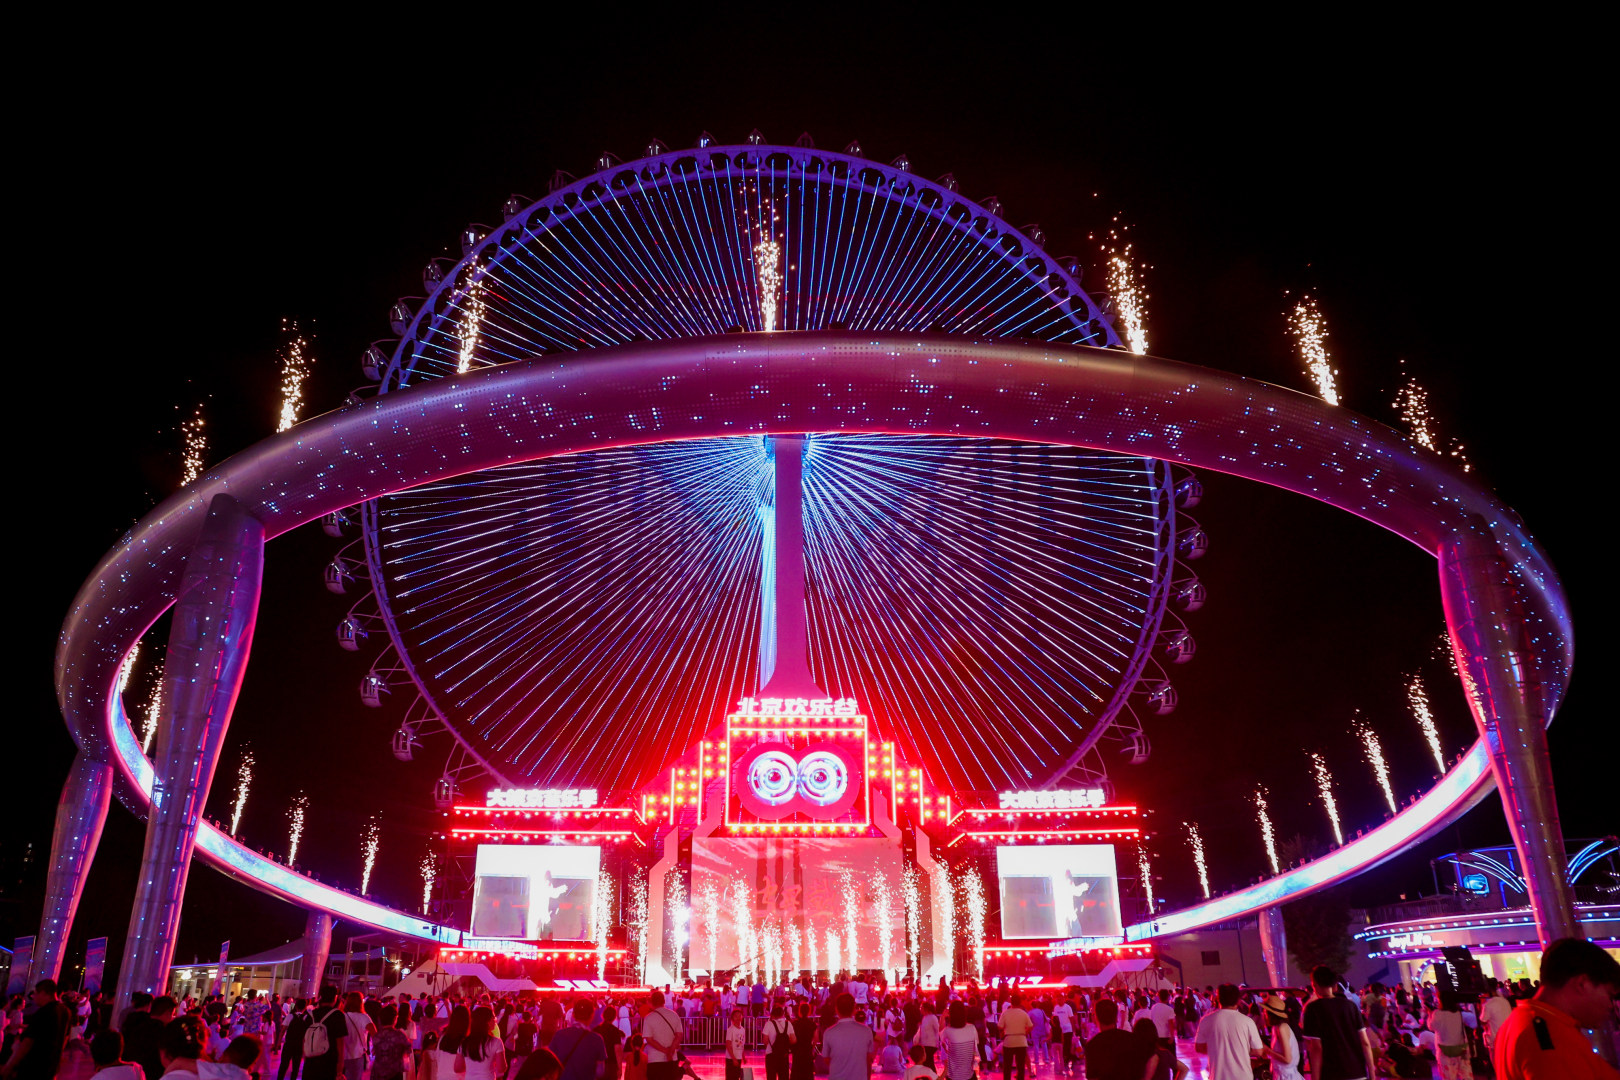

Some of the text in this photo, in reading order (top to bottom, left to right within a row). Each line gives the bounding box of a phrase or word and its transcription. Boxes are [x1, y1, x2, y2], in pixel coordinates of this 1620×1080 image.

[736, 697, 858, 715] 北京欢乐谷
